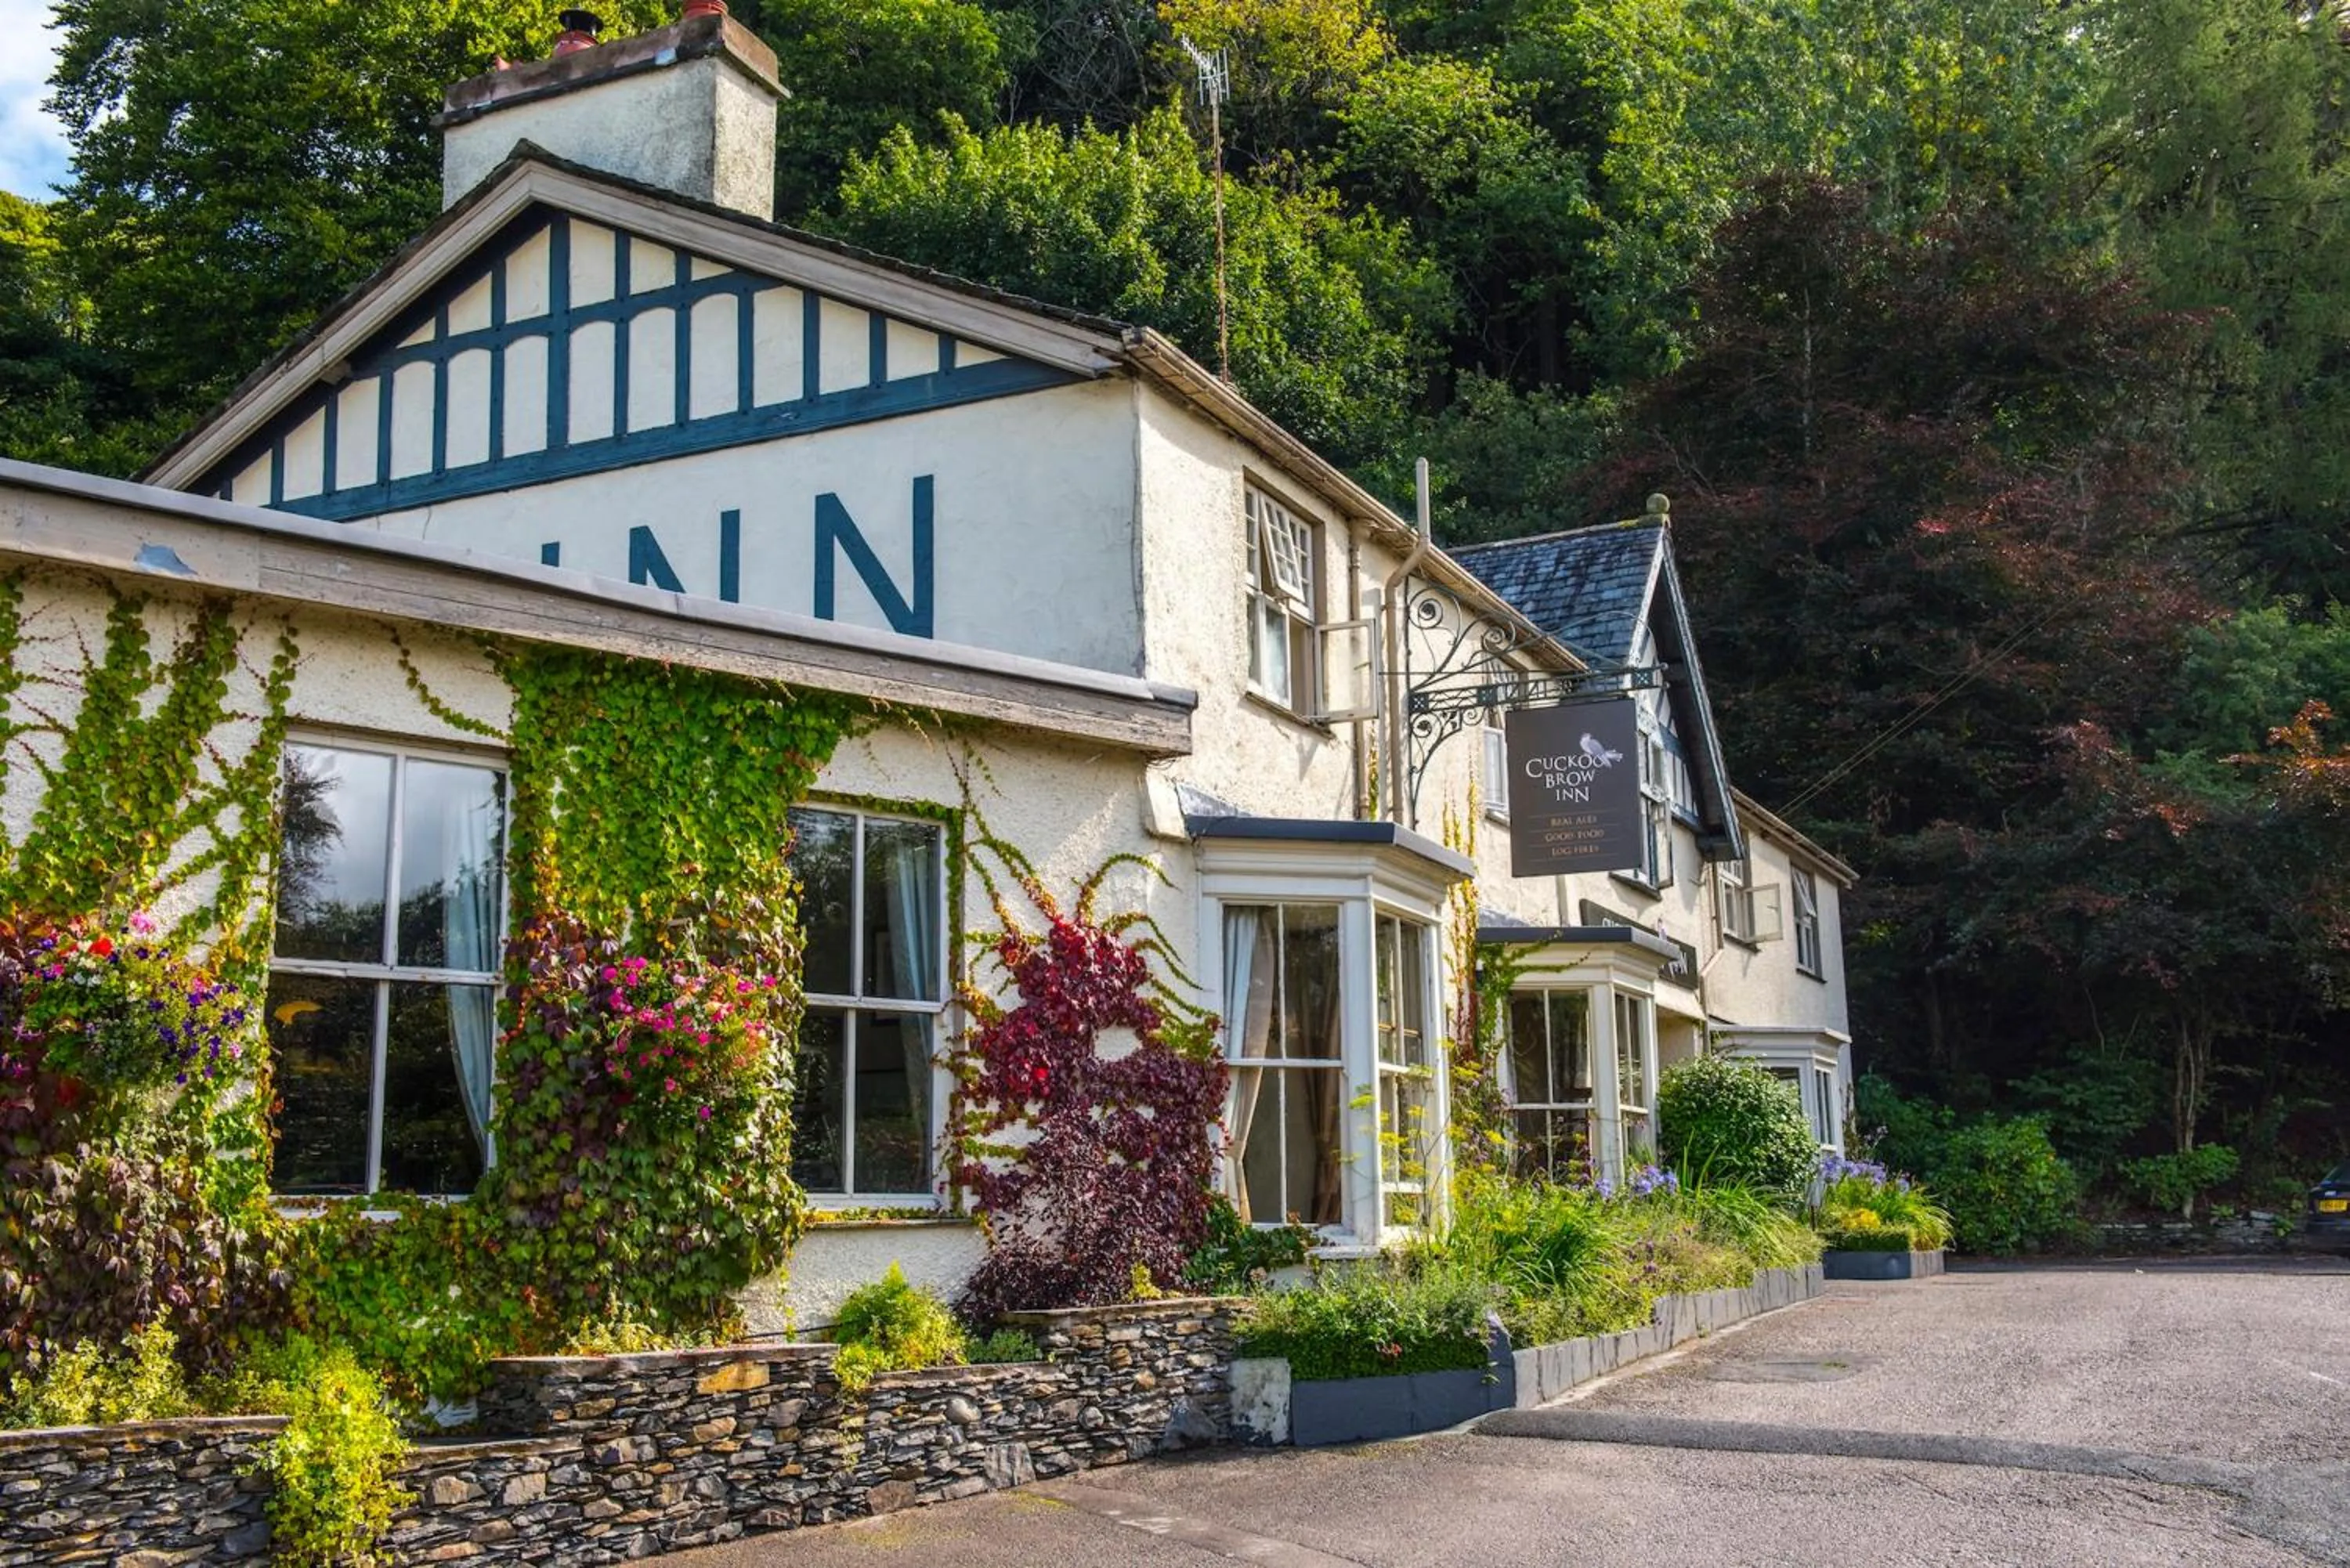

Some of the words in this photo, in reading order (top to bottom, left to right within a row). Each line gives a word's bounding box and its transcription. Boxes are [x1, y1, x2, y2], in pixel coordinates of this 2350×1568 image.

[541, 475, 934, 639] NN
[1525, 753, 1607, 778] CUCKOO
[1545, 769, 1596, 789] BROW
[1556, 786, 1589, 802] INN
[1546, 832, 1574, 842] GOOD
[1577, 829, 1604, 839] FOOD
